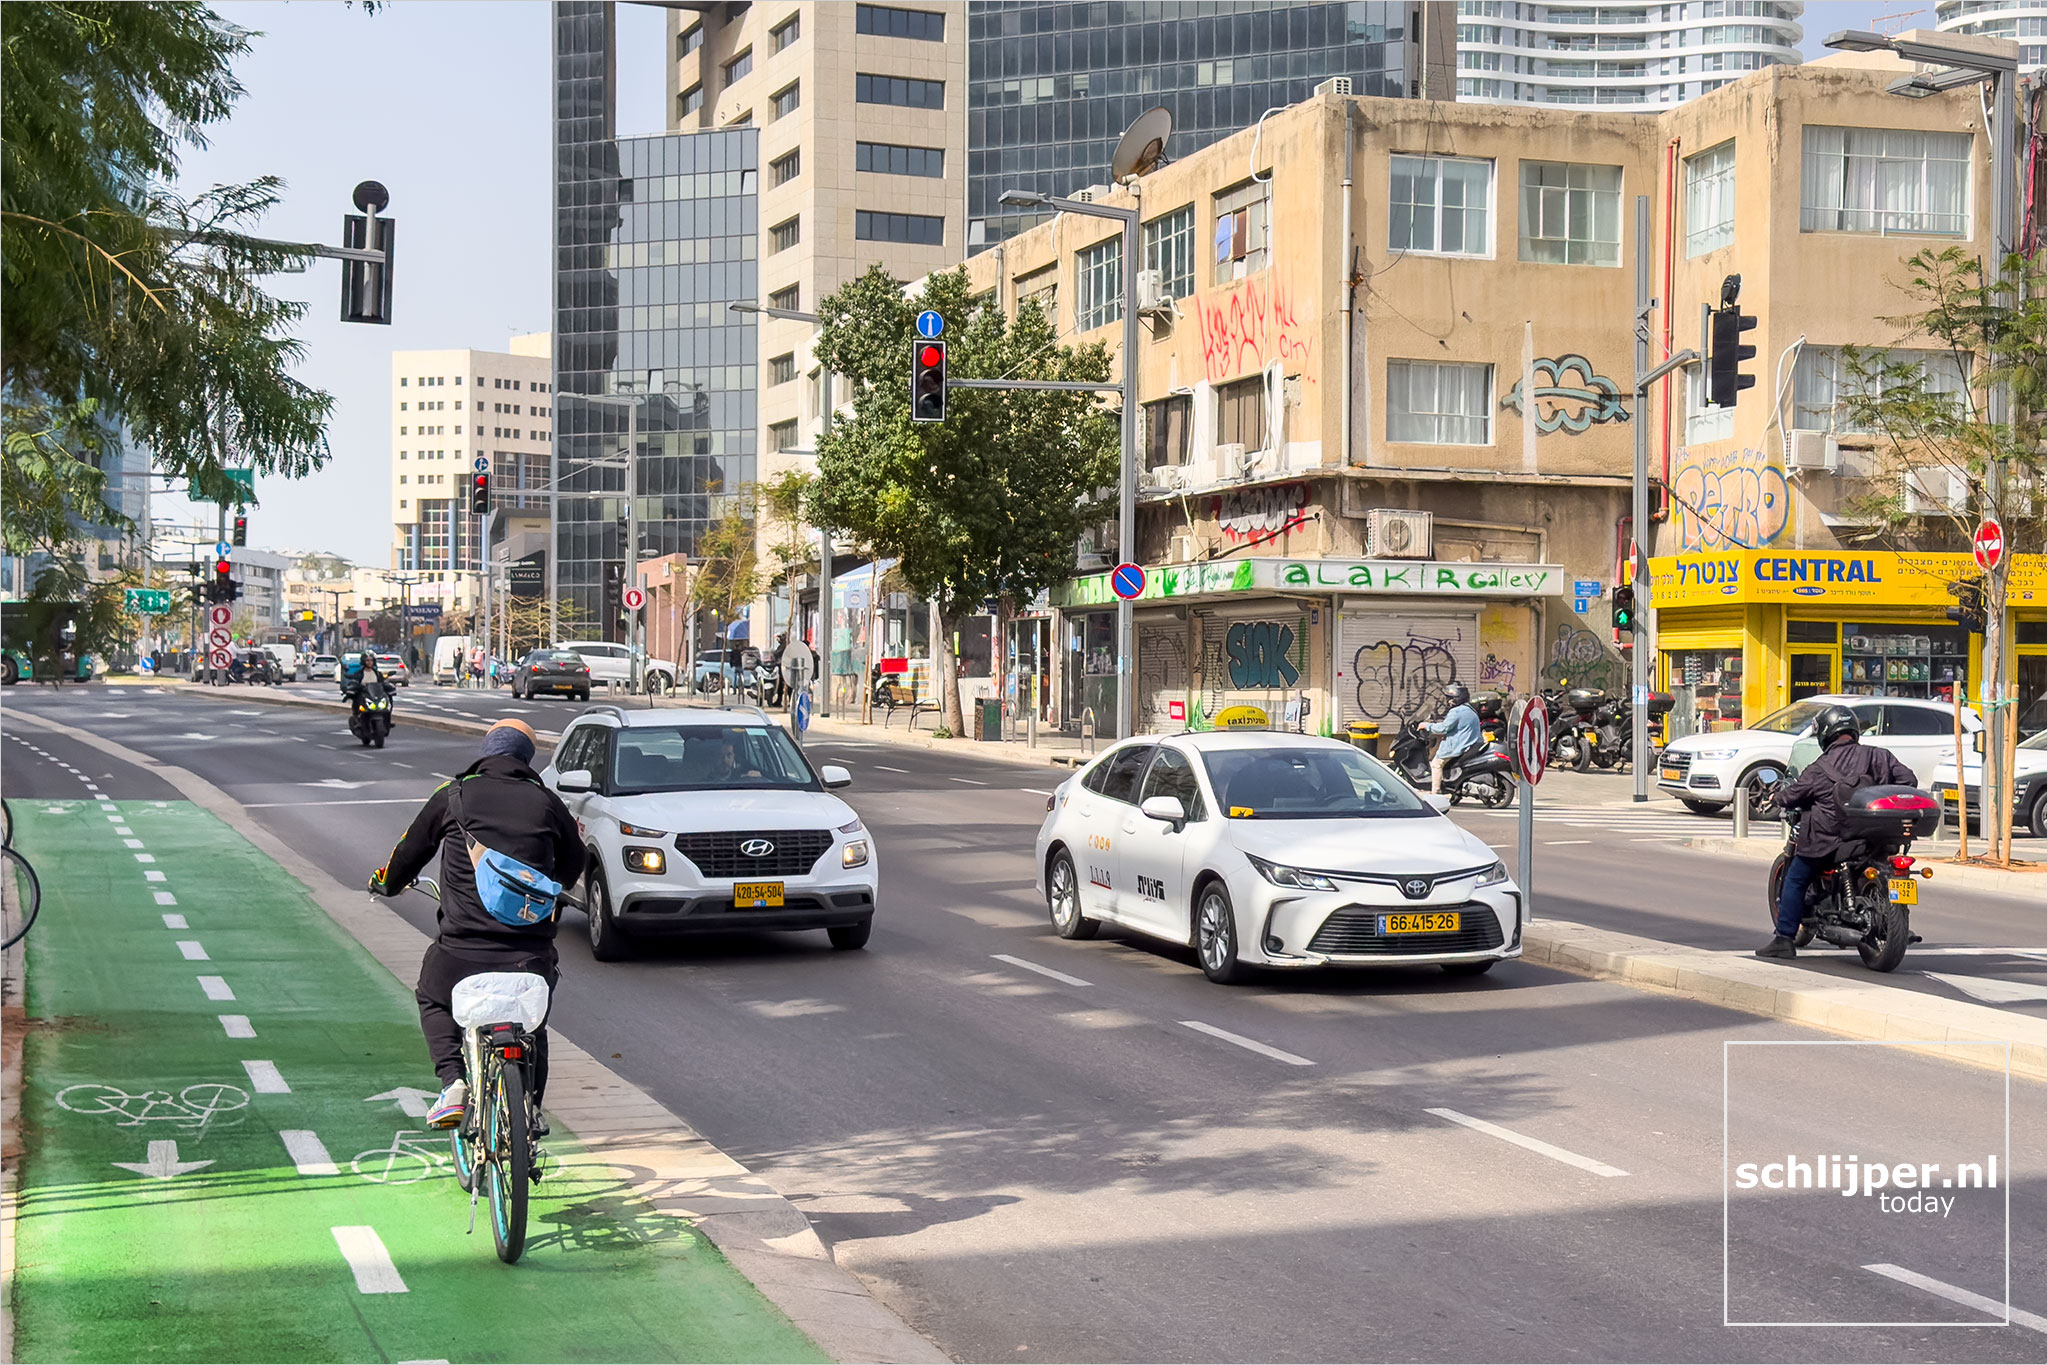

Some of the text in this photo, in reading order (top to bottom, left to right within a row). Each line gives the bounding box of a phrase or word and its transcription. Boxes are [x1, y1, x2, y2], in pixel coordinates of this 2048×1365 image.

[1676, 559, 1740, 585] צנטרל
[1754, 558, 1882, 583] CENTRAL
[1577, 601, 1583, 610] 1
[1227, 715, 1246, 725] taxi
